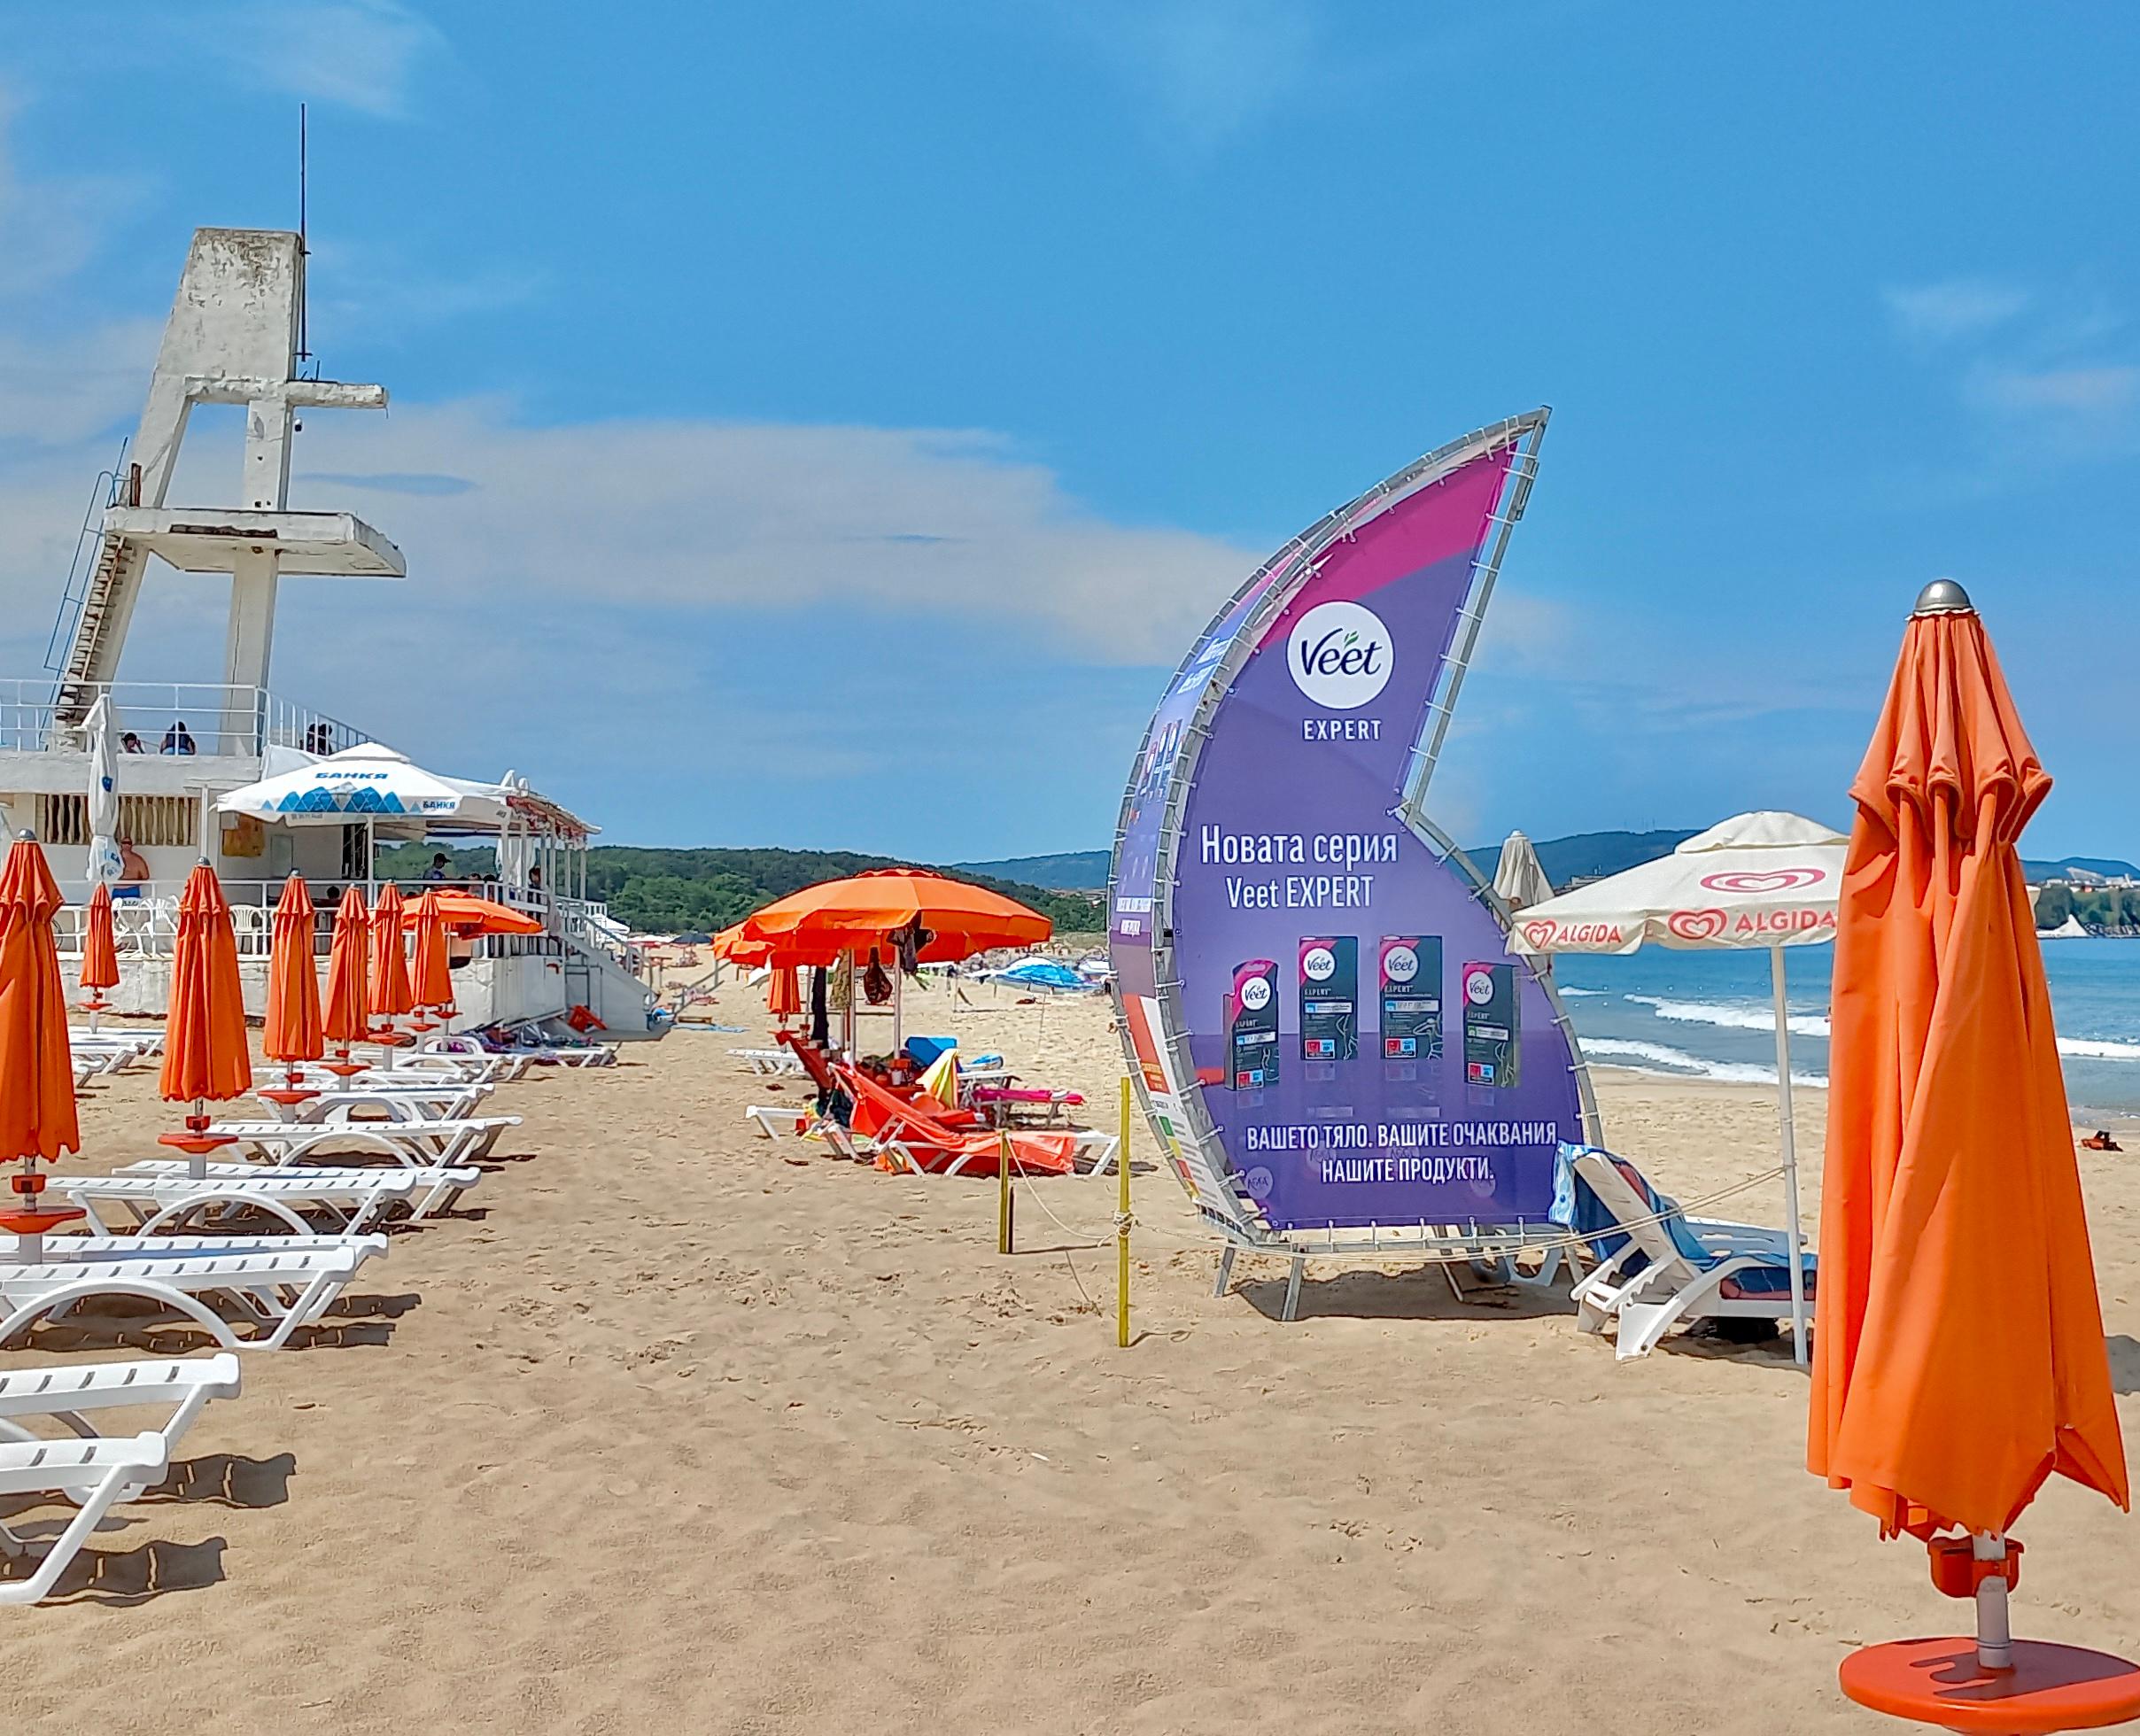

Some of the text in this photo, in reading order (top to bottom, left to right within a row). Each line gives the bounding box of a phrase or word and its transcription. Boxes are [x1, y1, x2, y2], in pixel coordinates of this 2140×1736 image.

[1301, 627, 1383, 676] Veet
[1303, 718, 1382, 740] EXPERT
[314, 771, 389, 780] БАНКЯ
[1202, 825, 1398, 872] Новата серия
[1226, 876, 1374, 908] Veet EXPERT
[1733, 909, 1837, 932] ALGIDA
[1555, 924, 1623, 944] ALGIDA
[1307, 956, 1332, 971] Veet
[1388, 955, 1415, 972] Veet
[1244, 984, 1268, 1001] Veet
[1469, 979, 1491, 995] Veet
[1247, 1121, 1557, 1150] ВАШЕТО ТЯЛО. ВАШИТЕ ОЧАКВАНИЯ
[1322, 1156, 1495, 1184] НАШИТЕ ПРОДУКТИ.
